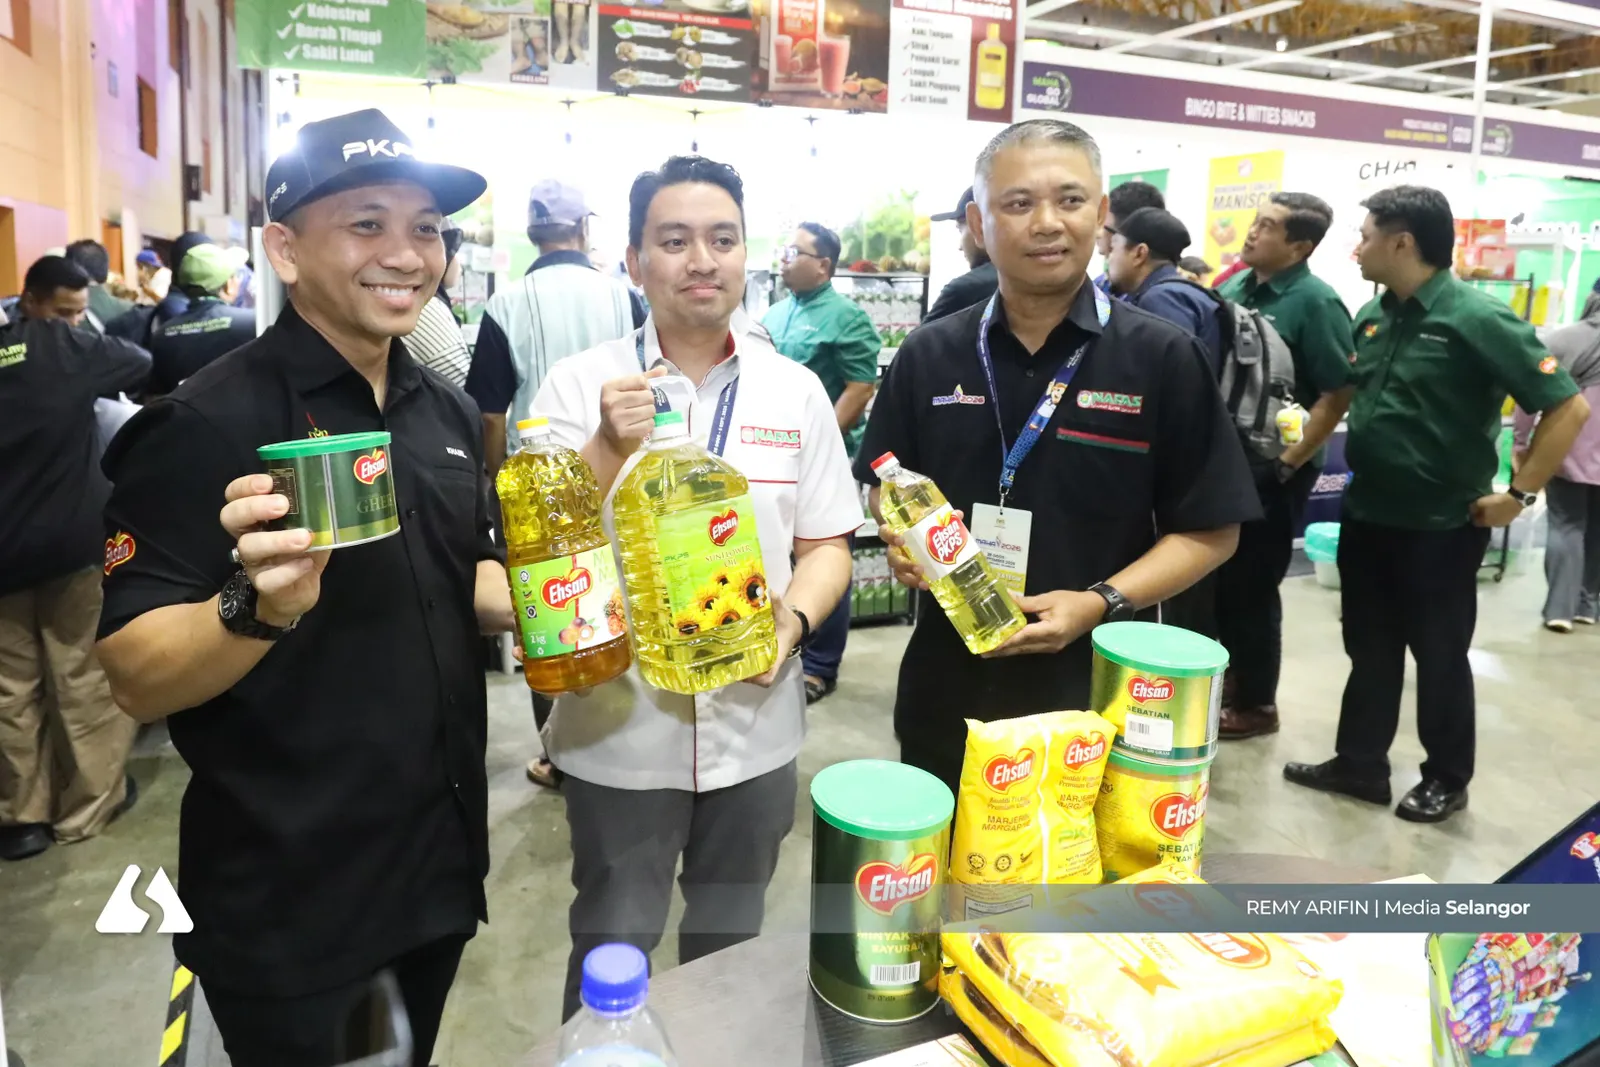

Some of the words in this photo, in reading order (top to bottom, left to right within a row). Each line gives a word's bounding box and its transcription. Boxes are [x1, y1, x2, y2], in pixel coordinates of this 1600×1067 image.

[296, 22, 338, 40] Darah
[339, 26, 382, 45] Tinggi
[302, 43, 338, 60] Sakit
[1185, 97, 1215, 118] BINGO
[1216, 101, 1237, 120] BITE
[1238, 103, 1245, 121] &
[1281, 108, 1316, 128] SNACKS
[361, 458, 385, 479] Ehsan
[712, 515, 738, 540] Ehsan
[932, 520, 960, 548] Ehsan
[937, 531, 963, 563] PKPS
[548, 576, 589, 605] Ehsan
[1132, 682, 1170, 698] Ehsan
[1126, 704, 1171, 719] SEBATIAN
[1066, 741, 1104, 765] Ehsan
[992, 759, 1031, 786] Ehsan
[869, 866, 932, 903] Ehsan
[857, 931, 910, 942] MINYAK
